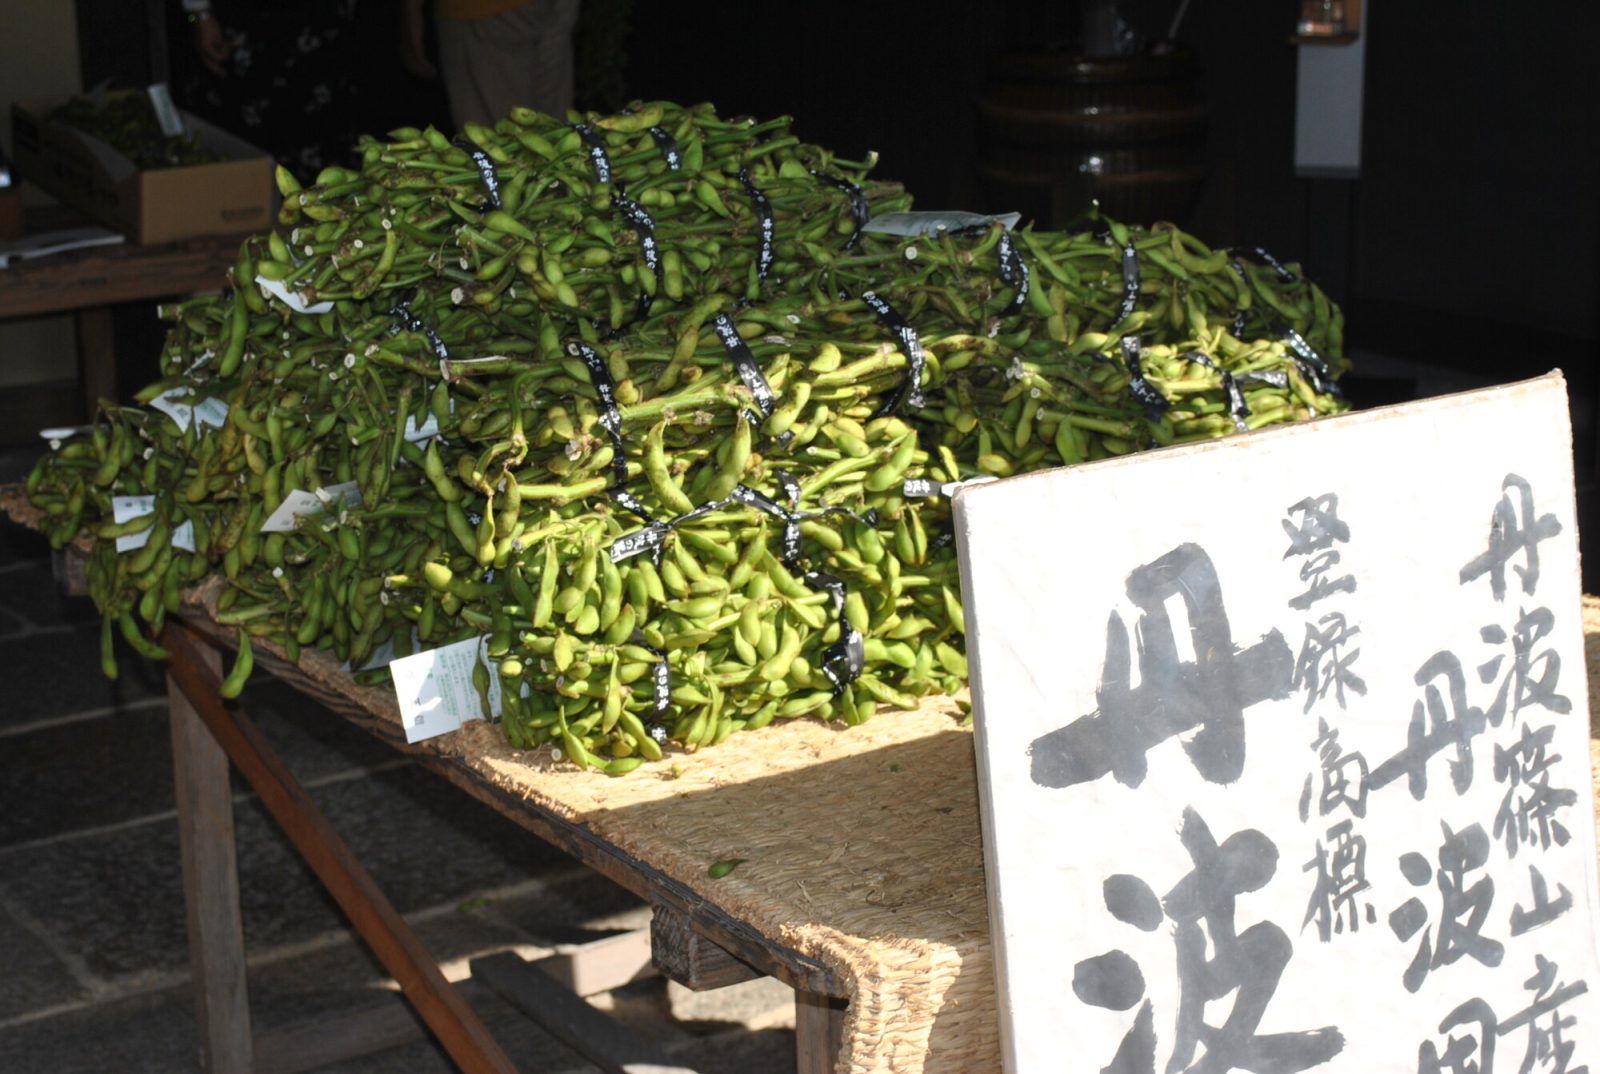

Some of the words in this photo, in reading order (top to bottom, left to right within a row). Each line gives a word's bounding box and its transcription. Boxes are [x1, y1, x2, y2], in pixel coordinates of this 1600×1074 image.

[1026, 542, 1348, 1074] 丹波
[1281, 492, 1377, 942] 登録商標
